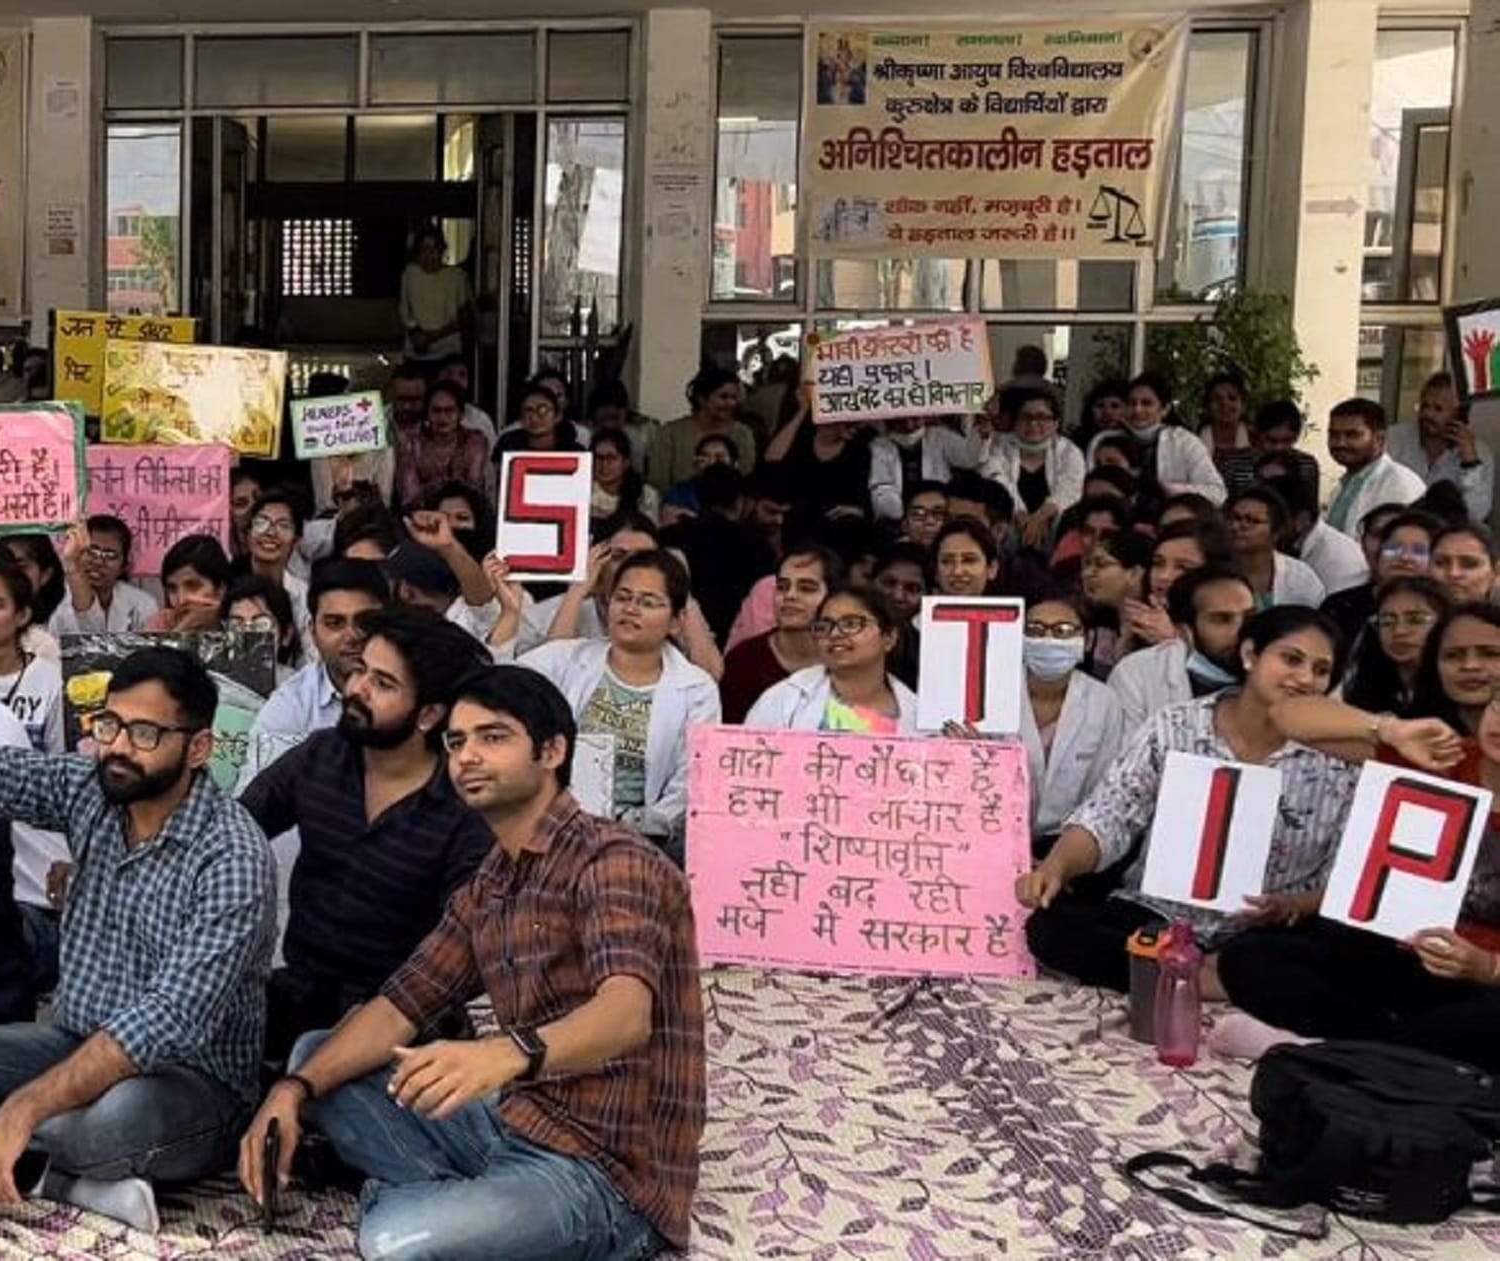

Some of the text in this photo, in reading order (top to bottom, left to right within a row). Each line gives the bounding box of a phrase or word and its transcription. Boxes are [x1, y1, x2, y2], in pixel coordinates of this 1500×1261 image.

[949, 63, 1003, 88] आयुष
[1007, 56, 1124, 80] विश्वविद्यालय
[885, 92, 953, 123] कुरुक्षेत्र
[959, 92, 979, 115] के
[1071, 97, 1108, 117] द्वारा
[818, 126, 1154, 179] अनिश्चितकालीन हड़ताल
[887, 223, 902, 241] ये
[505, 457, 579, 574] S
[932, 603, 1020, 728] T
[803, 742, 851, 784] की
[728, 785, 783, 820] हम
[805, 785, 850, 827] भी
[868, 799, 966, 833] लाचार
[1348, 777, 1478, 922] P
[908, 876, 974, 916] रही
[858, 917, 982, 957] सरकार
[984, 914, 1016, 957] है
